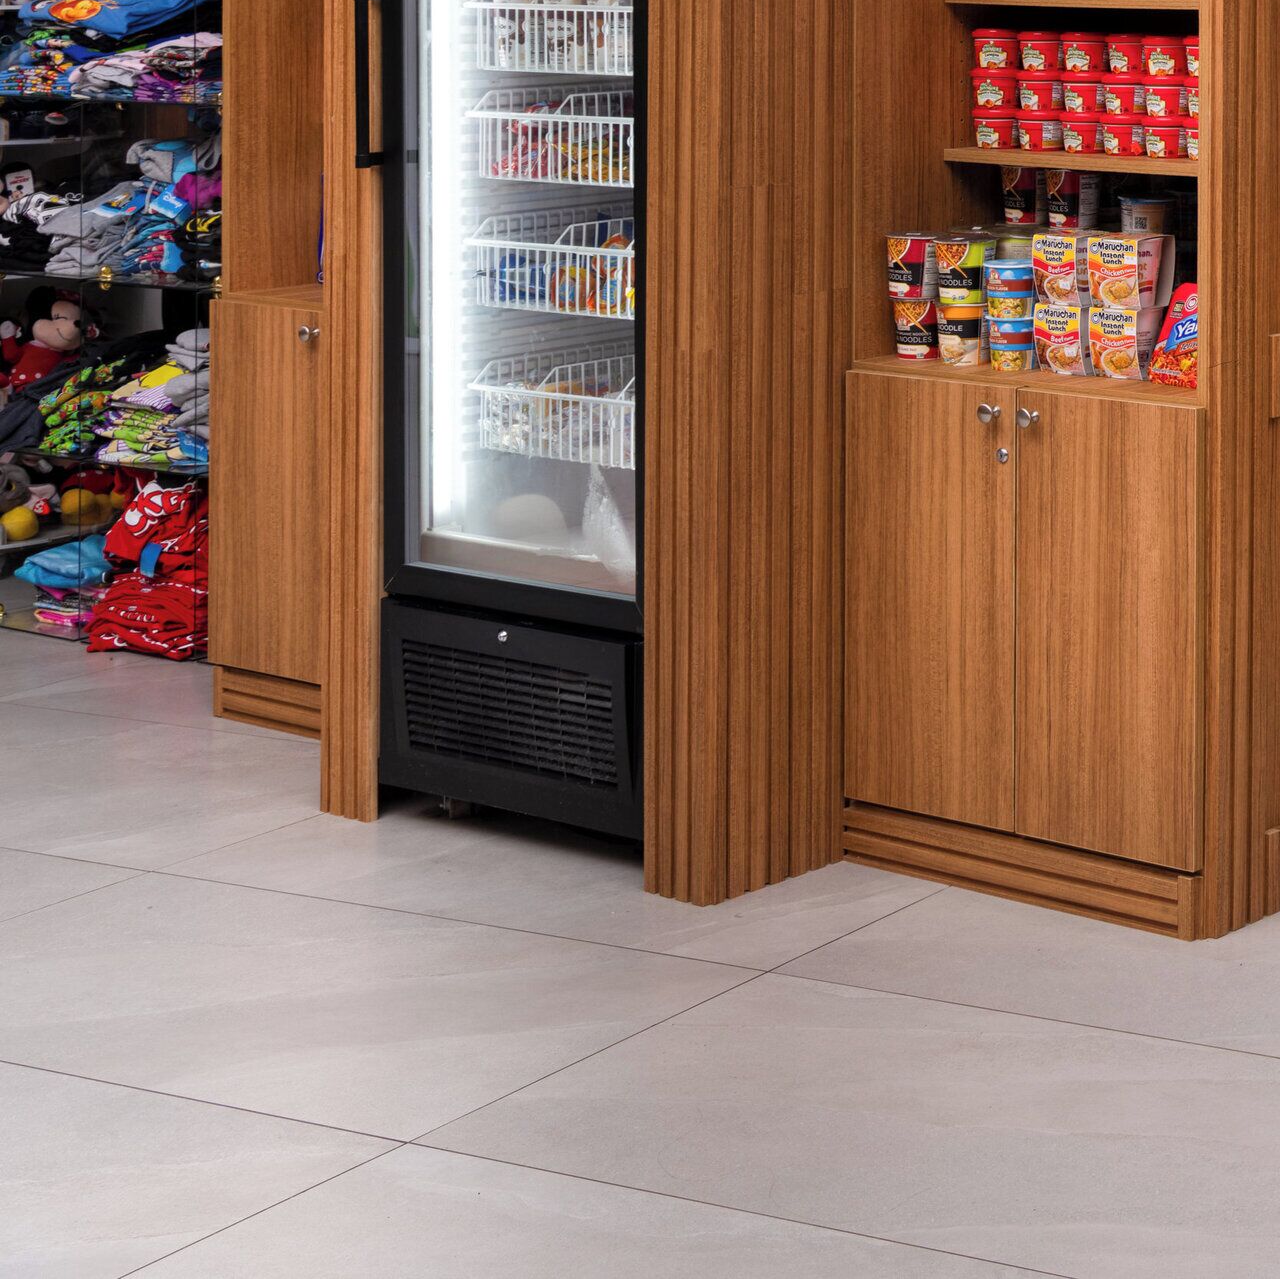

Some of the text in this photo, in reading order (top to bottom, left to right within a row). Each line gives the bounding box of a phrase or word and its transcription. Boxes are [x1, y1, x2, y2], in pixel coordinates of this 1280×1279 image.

[162, 194, 183, 208] Disney
[1041, 239, 1073, 249] Maruchan
[1098, 241, 1134, 252] Maruchan
[1043, 249, 1065, 257] Instant
[1047, 265, 1058, 273] Beef
[1044, 310, 1077, 319] Maruchan
[1098, 312, 1133, 322] Maruchan
[1046, 318, 1068, 326] Instant
[1101, 322, 1124, 330] Instant
[1101, 337, 1123, 345] Chicken
